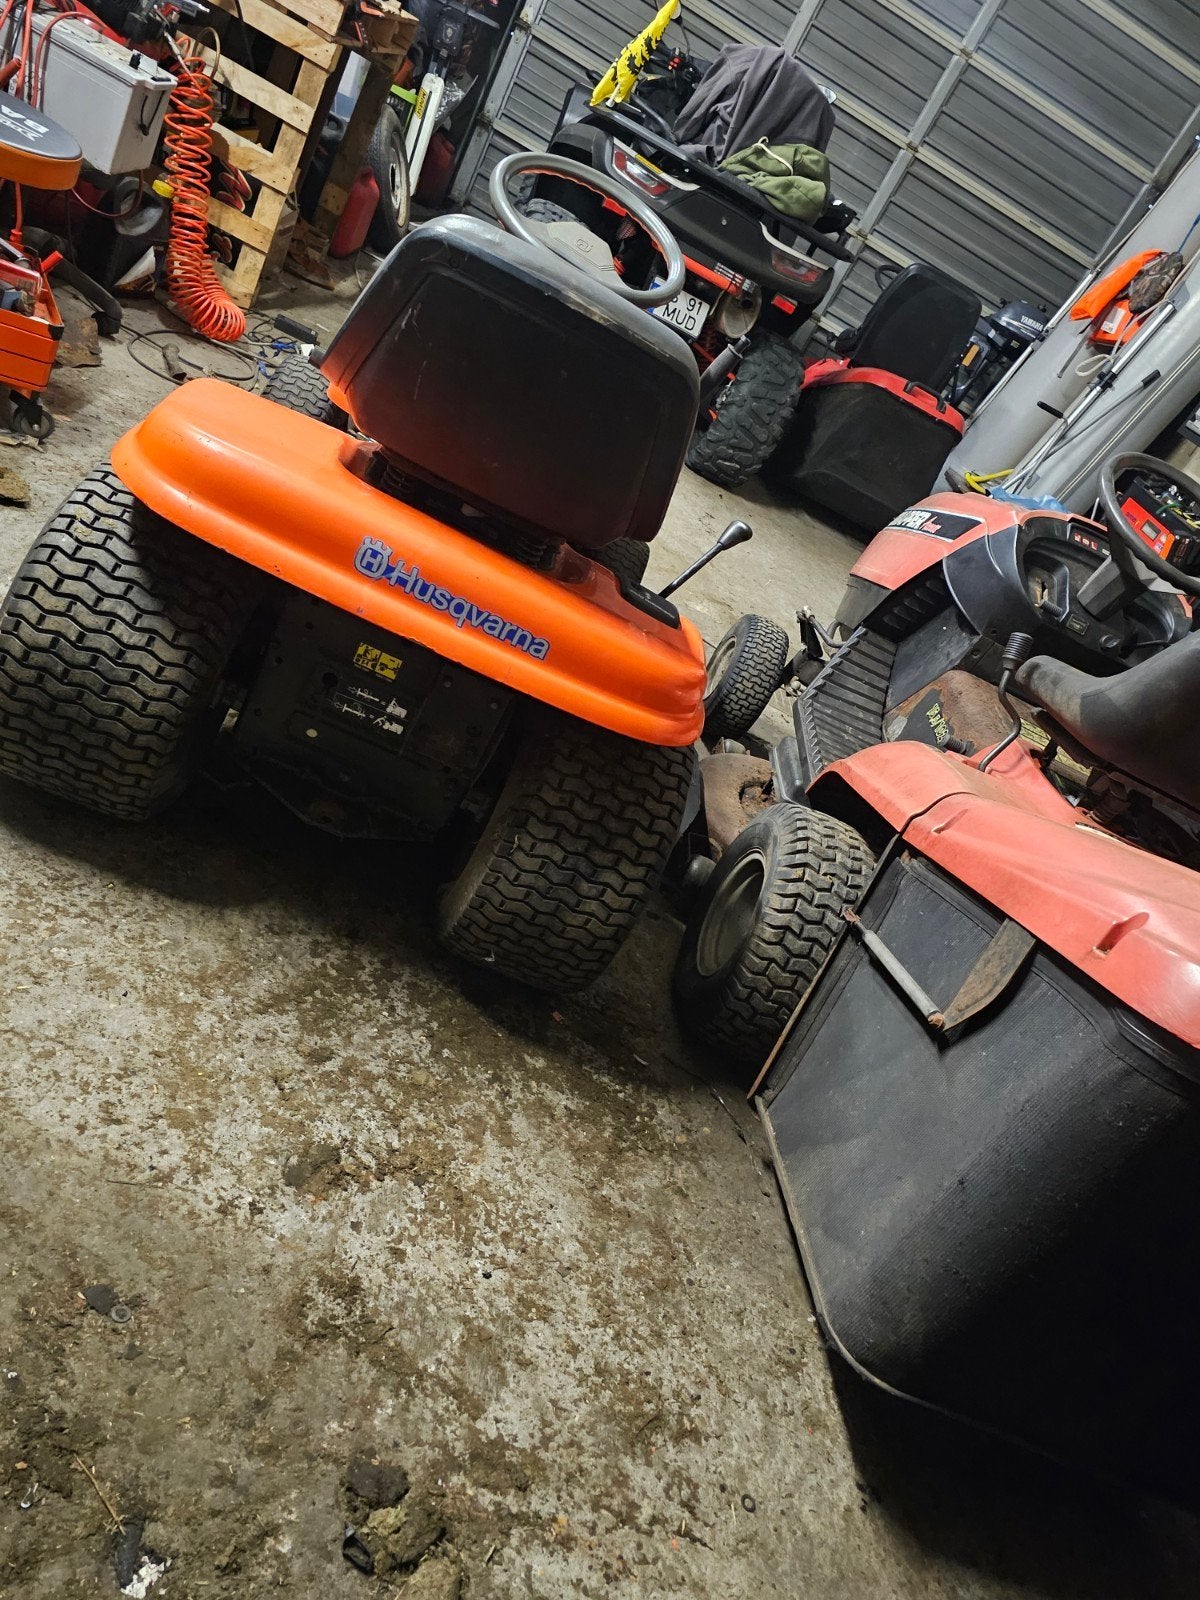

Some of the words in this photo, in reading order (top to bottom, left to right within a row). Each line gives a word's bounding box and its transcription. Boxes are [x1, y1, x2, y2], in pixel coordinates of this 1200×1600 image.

[662, 303, 697, 331] MUD
[686, 297, 703, 315] 91
[1020, 315, 1044, 331] YAMAHA
[388, 559, 551, 661] Husqvarna
